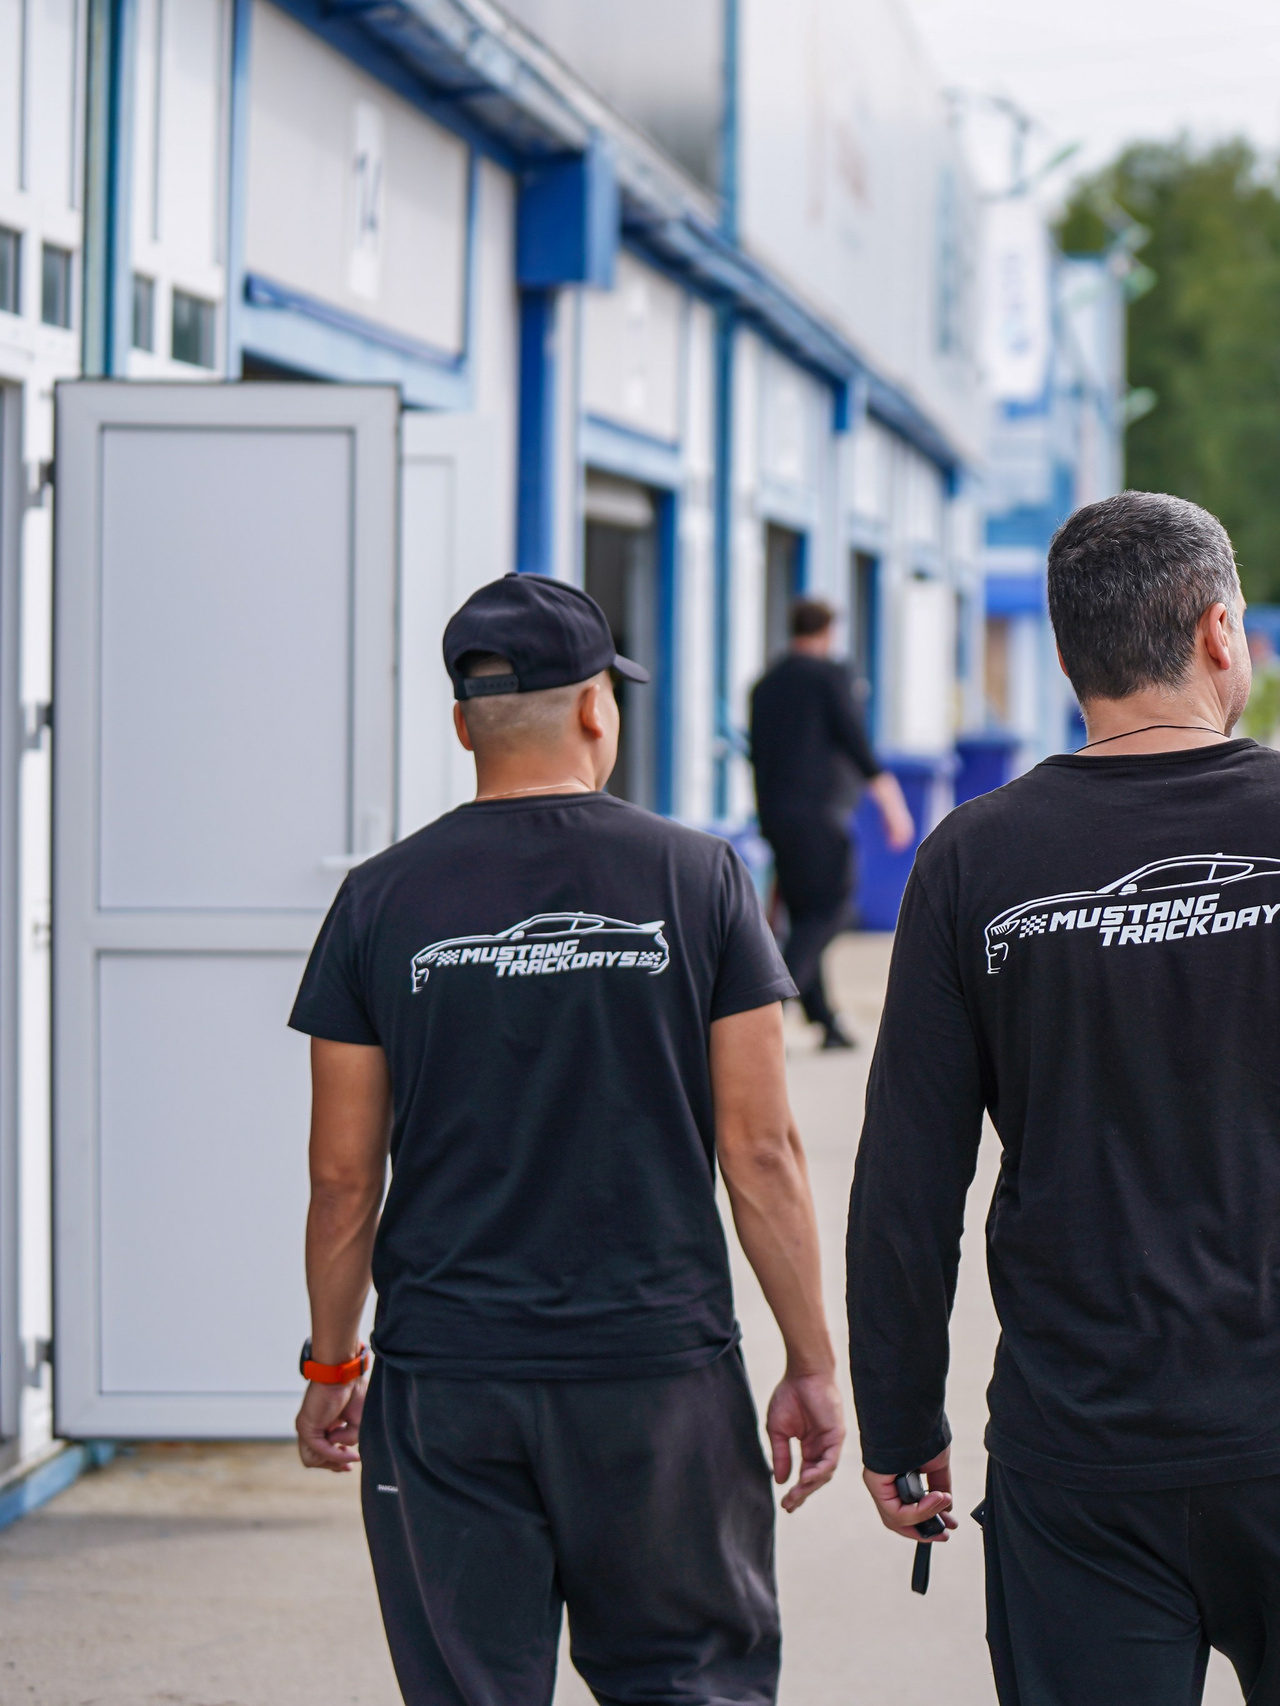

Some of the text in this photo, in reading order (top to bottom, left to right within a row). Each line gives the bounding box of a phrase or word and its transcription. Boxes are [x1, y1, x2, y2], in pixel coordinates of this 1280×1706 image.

[1049, 893, 1219, 931] MUSTANG
[460, 939, 580, 963] MUSTANG
[494, 951, 638, 977] TRACKDAYS
